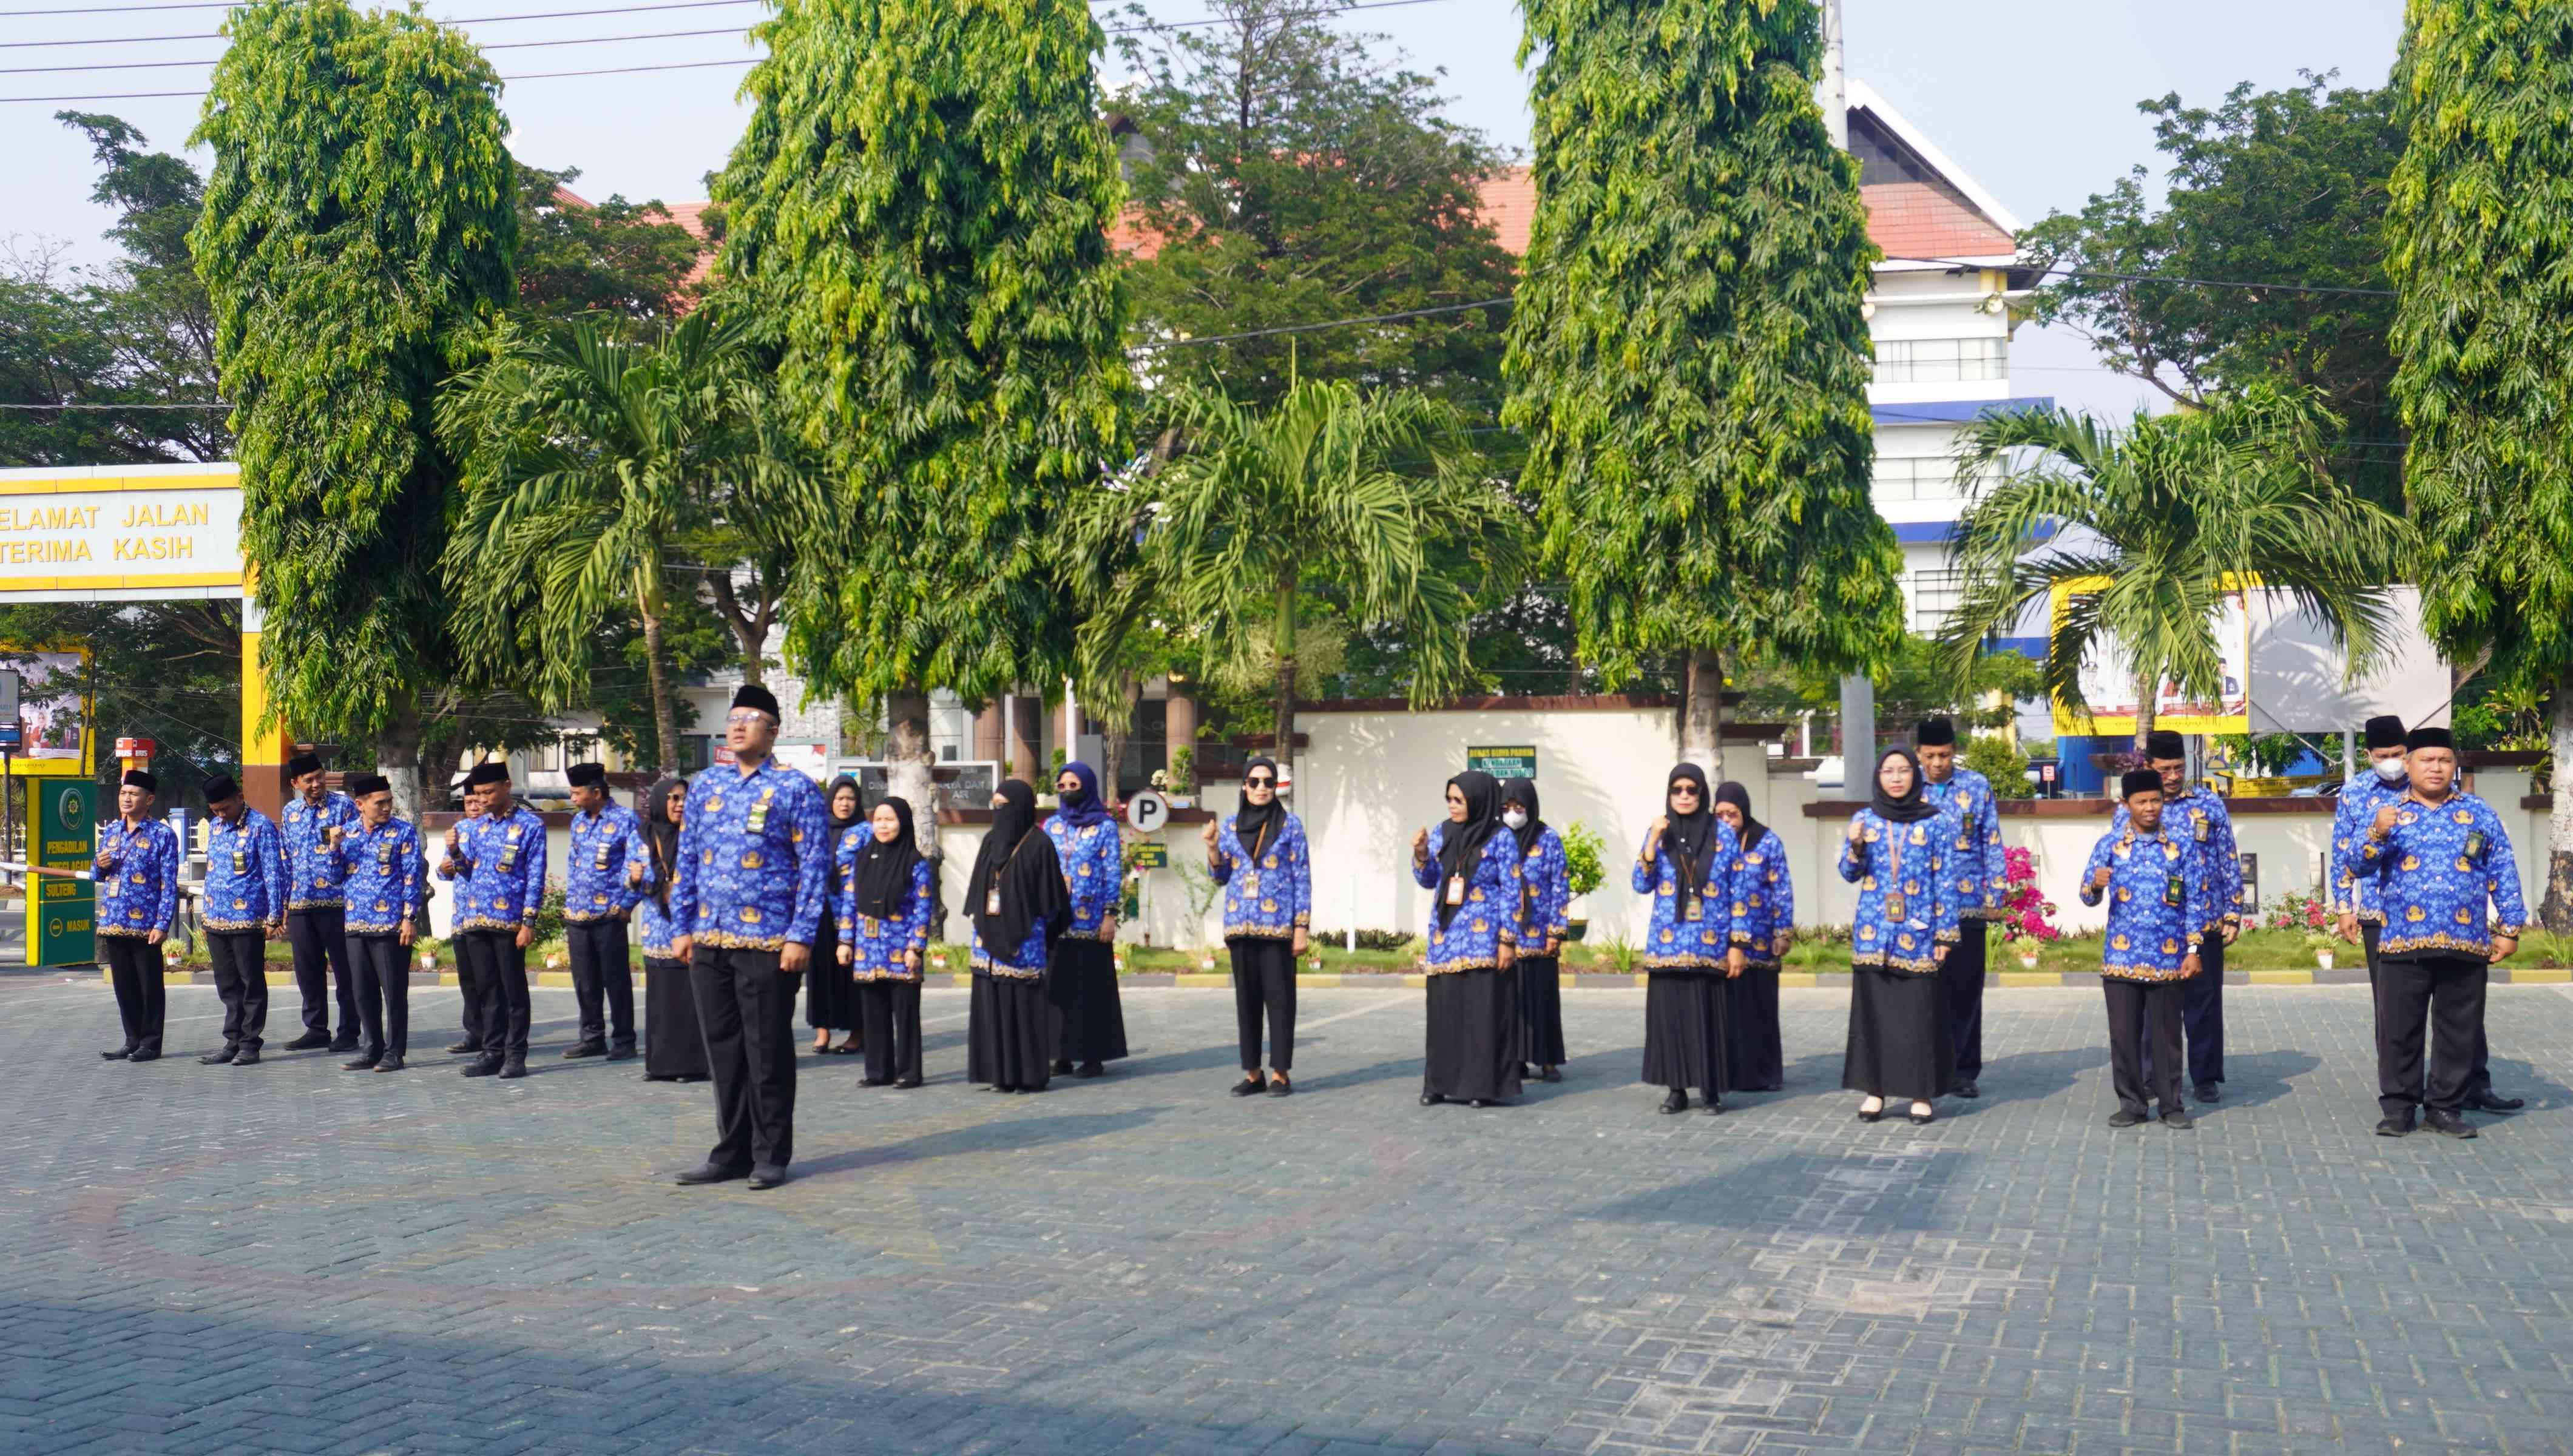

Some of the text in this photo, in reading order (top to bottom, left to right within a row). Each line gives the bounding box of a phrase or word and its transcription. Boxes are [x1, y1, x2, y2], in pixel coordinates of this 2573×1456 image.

[0, 504, 208, 530] ELAMAT JALAN
[0, 536, 192, 564] TERIMA KASIH
[1138, 800, 1157, 824] P
[47, 840, 87, 854] PENGADILAN
[46, 883, 77, 897] SULTENG
[67, 919, 91, 932] MASUK
